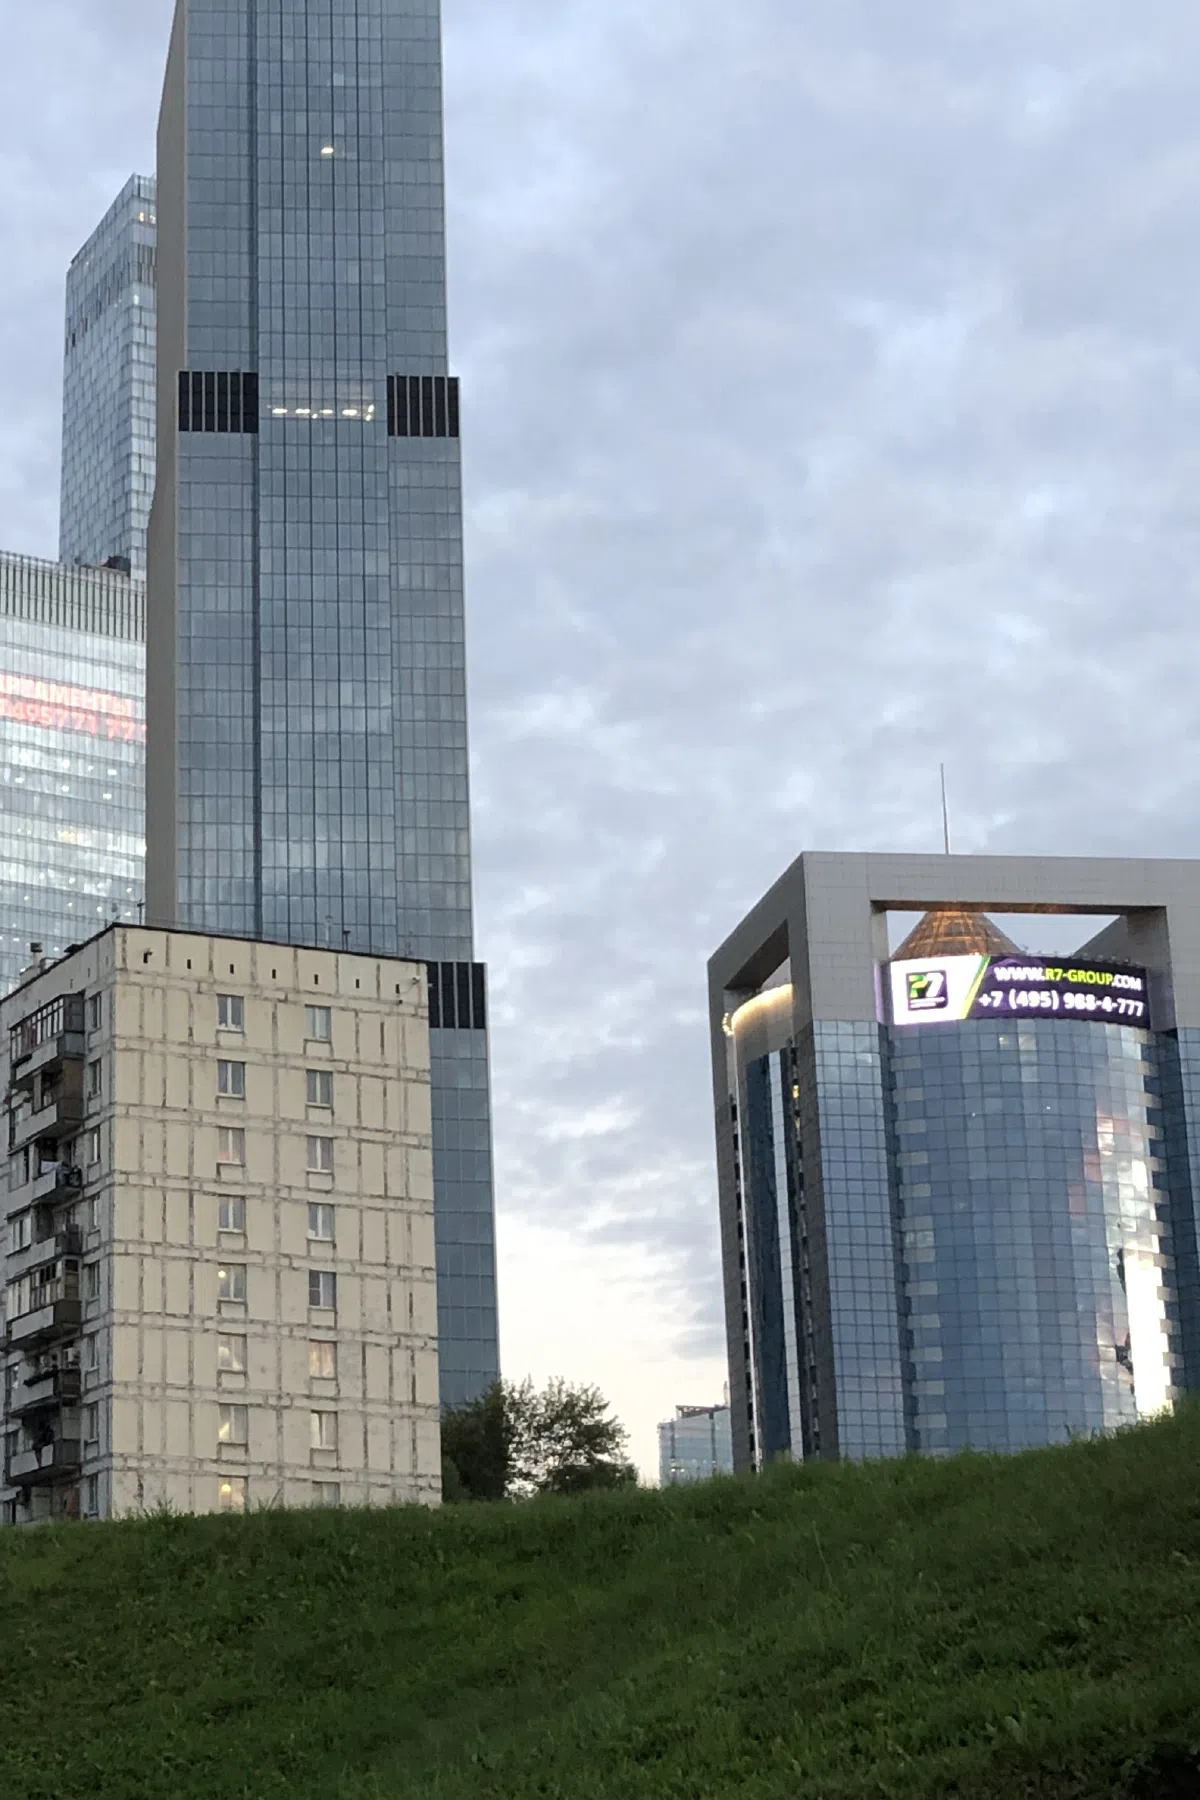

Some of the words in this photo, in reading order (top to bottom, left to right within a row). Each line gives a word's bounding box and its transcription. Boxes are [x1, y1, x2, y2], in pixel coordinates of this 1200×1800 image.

[994, 966, 1142, 991] WWW.R7-GROUP.COM
[978, 990, 1004, 1007] +7
[1008, 988, 1059, 1010] (495)
